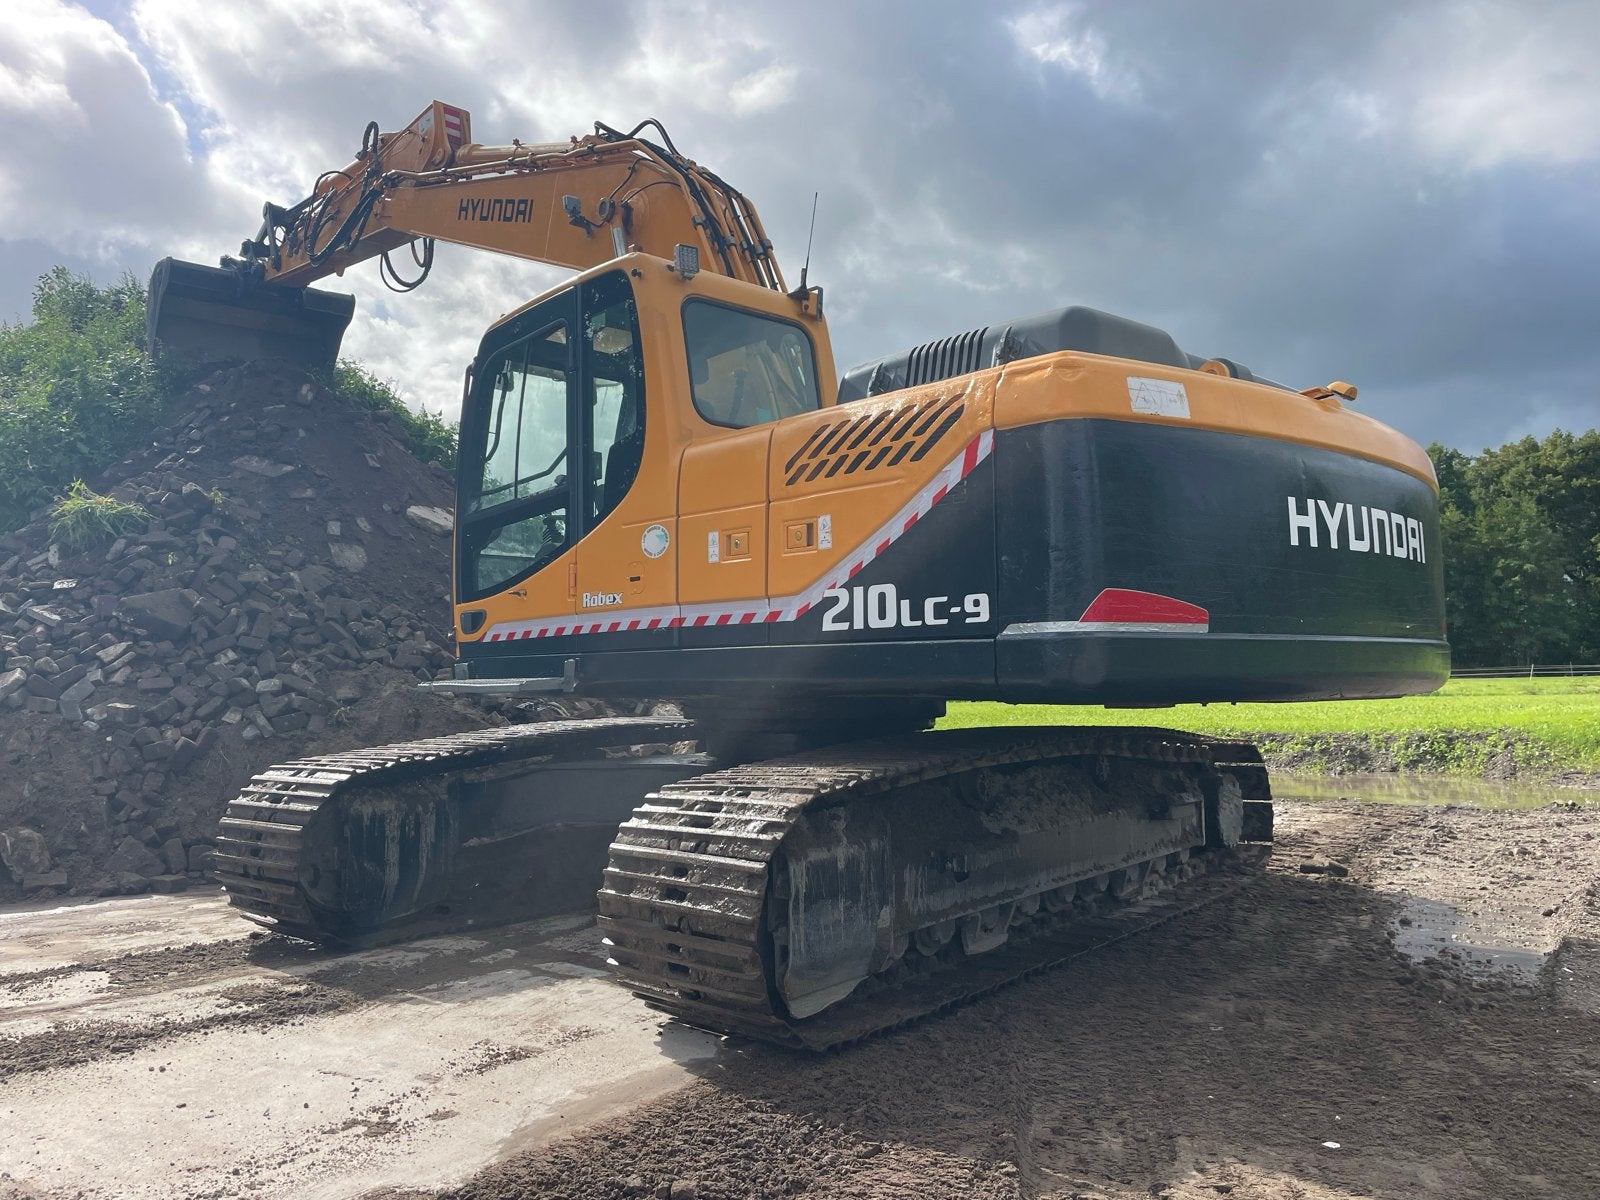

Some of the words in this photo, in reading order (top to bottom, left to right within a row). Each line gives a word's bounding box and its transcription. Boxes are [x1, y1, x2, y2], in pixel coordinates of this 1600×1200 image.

[457, 198, 534, 223] HYUNDAI
[1287, 496, 1426, 564] HYUNDAI
[582, 591, 624, 608] Robex
